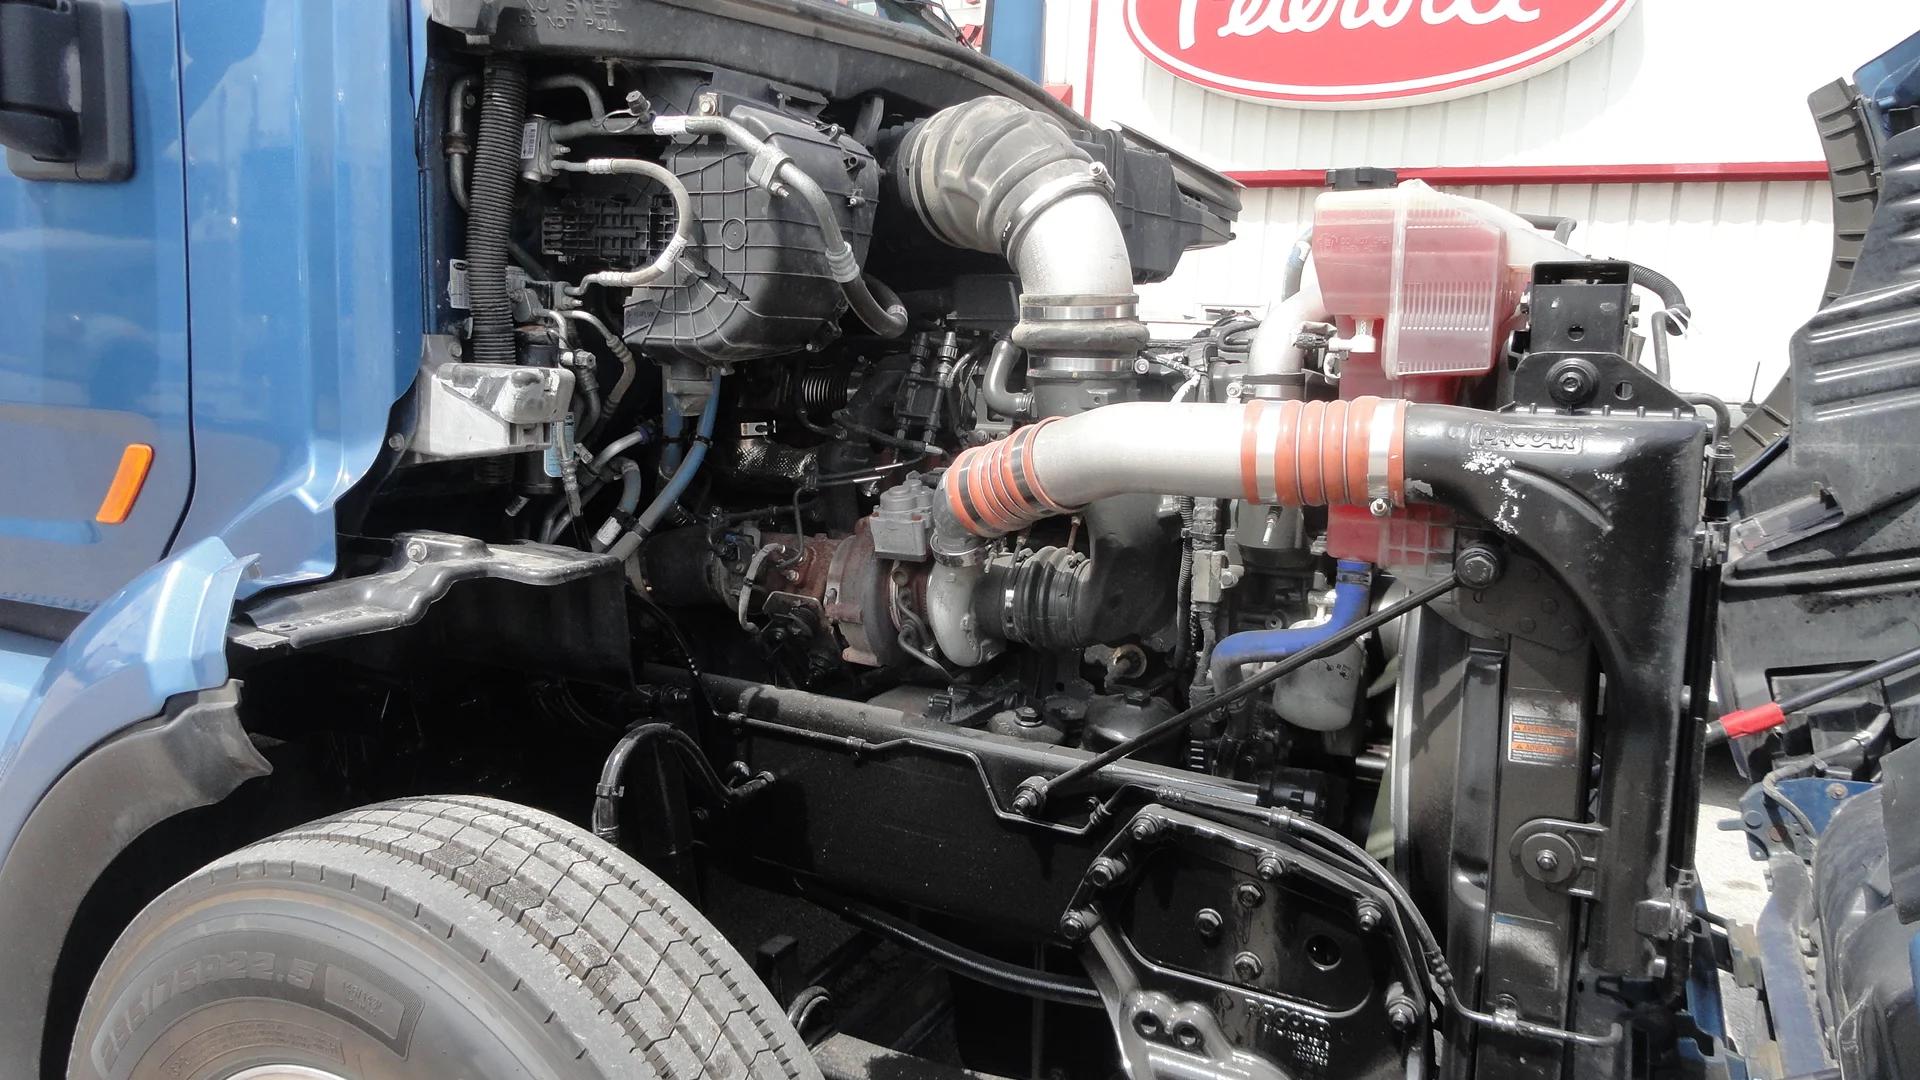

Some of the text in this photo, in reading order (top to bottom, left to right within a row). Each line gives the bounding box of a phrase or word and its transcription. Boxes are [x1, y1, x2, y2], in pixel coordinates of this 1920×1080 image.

[546, 15, 576, 31] NOT
[584, 18, 626, 34] PULL
[1478, 430, 1576, 449] PACCAR
